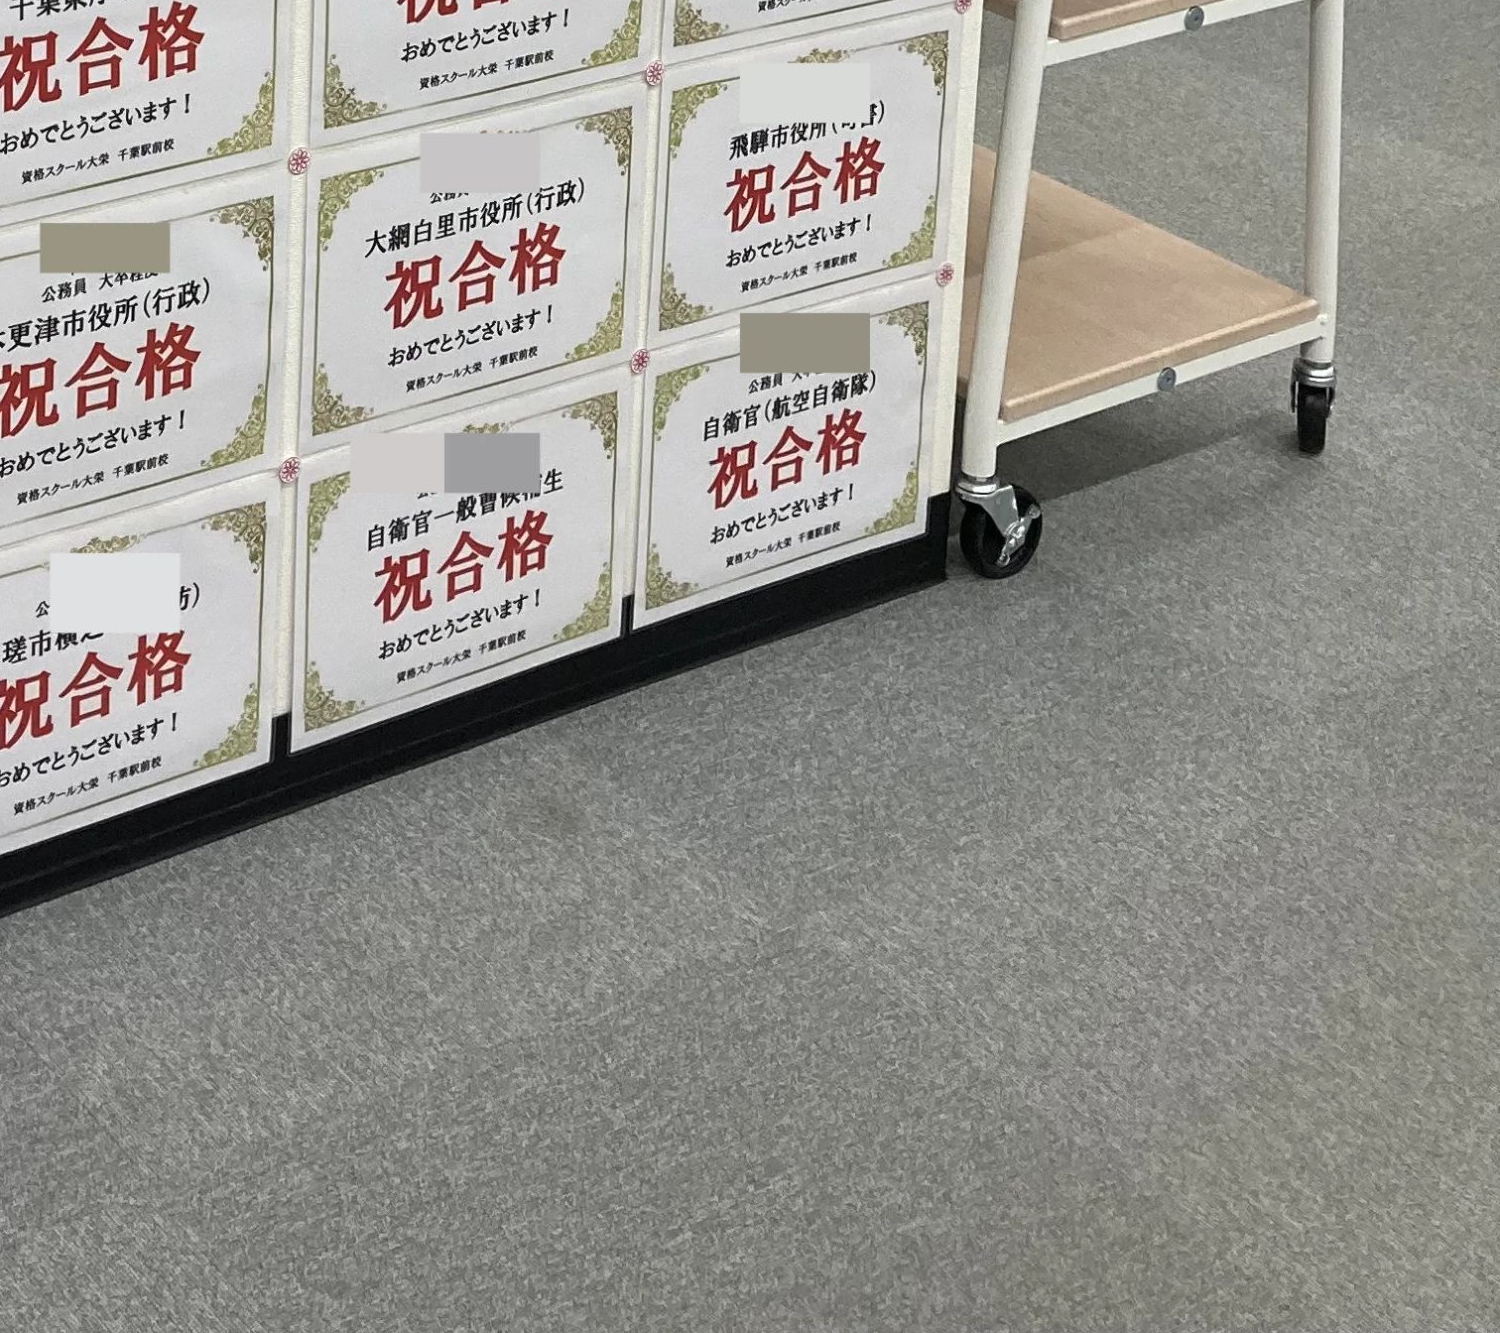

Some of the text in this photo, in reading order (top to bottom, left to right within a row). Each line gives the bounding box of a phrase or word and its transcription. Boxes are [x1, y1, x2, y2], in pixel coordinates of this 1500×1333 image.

[419, 49, 554, 91] 資格スクール大栄 千葉駅前校
[41, 277, 87, 303] 公務員
[374, 509, 554, 625] 祝合格
